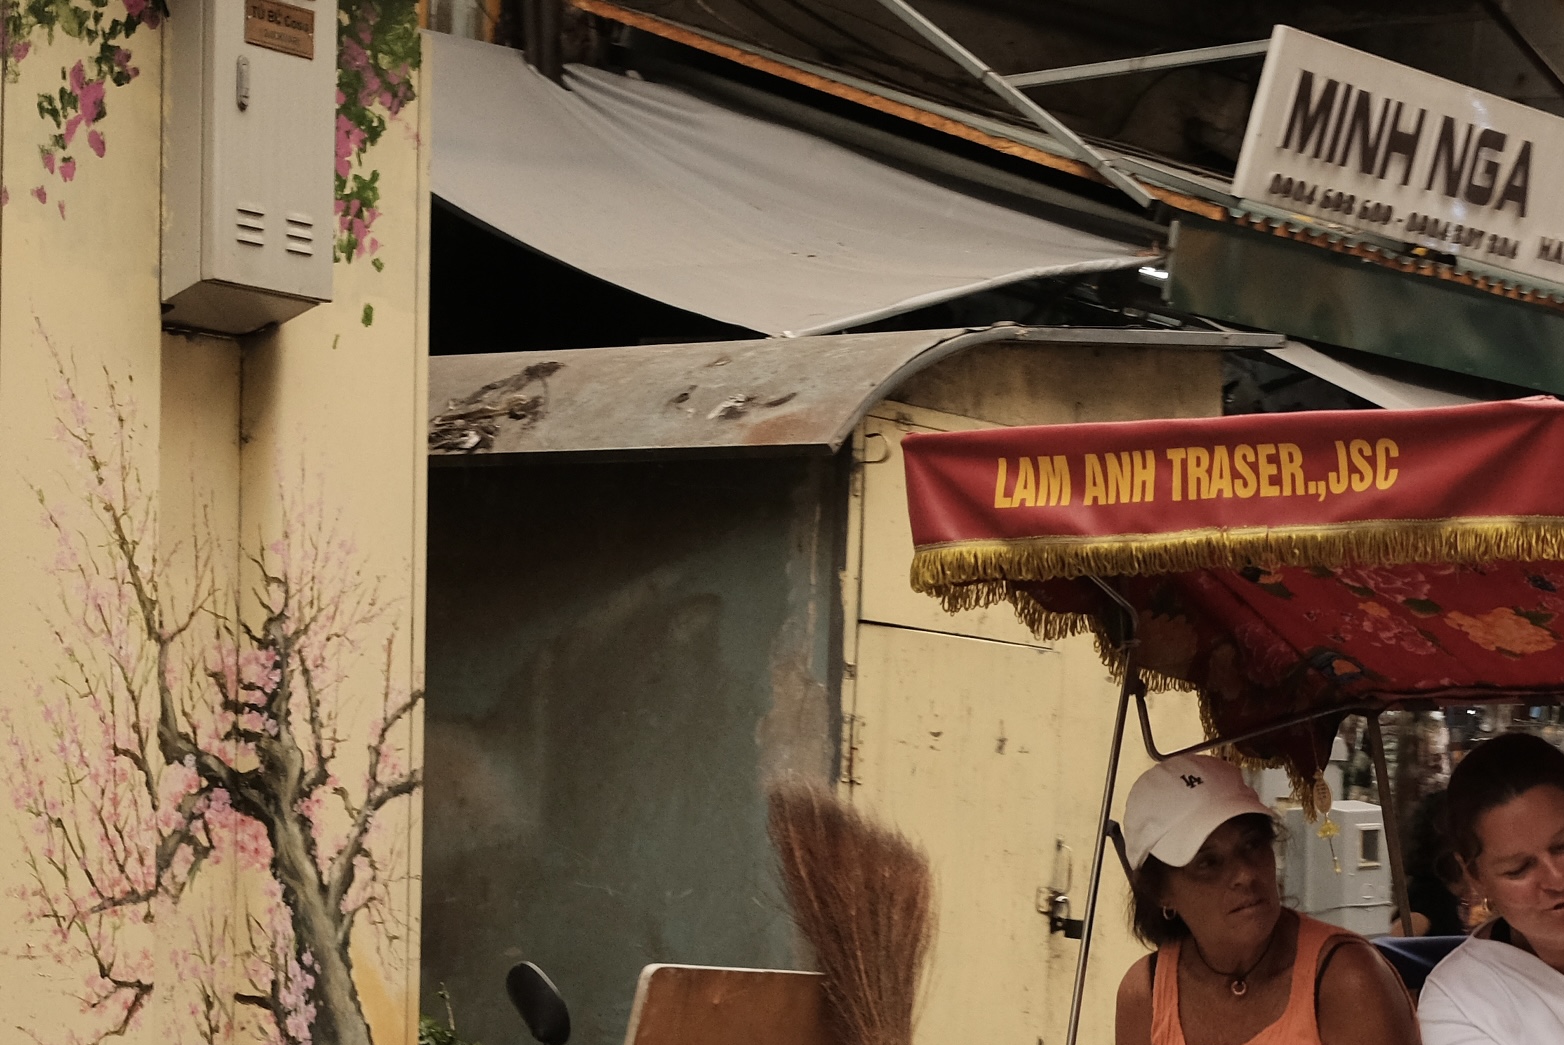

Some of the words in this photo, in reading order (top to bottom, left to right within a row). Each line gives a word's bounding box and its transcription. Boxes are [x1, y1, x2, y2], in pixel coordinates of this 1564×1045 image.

[1276, 68, 1427, 186] MINH
[1424, 114, 1535, 218] NGA
[993, 454, 1070, 509] LAM
[1083, 448, 1156, 506] ANH
